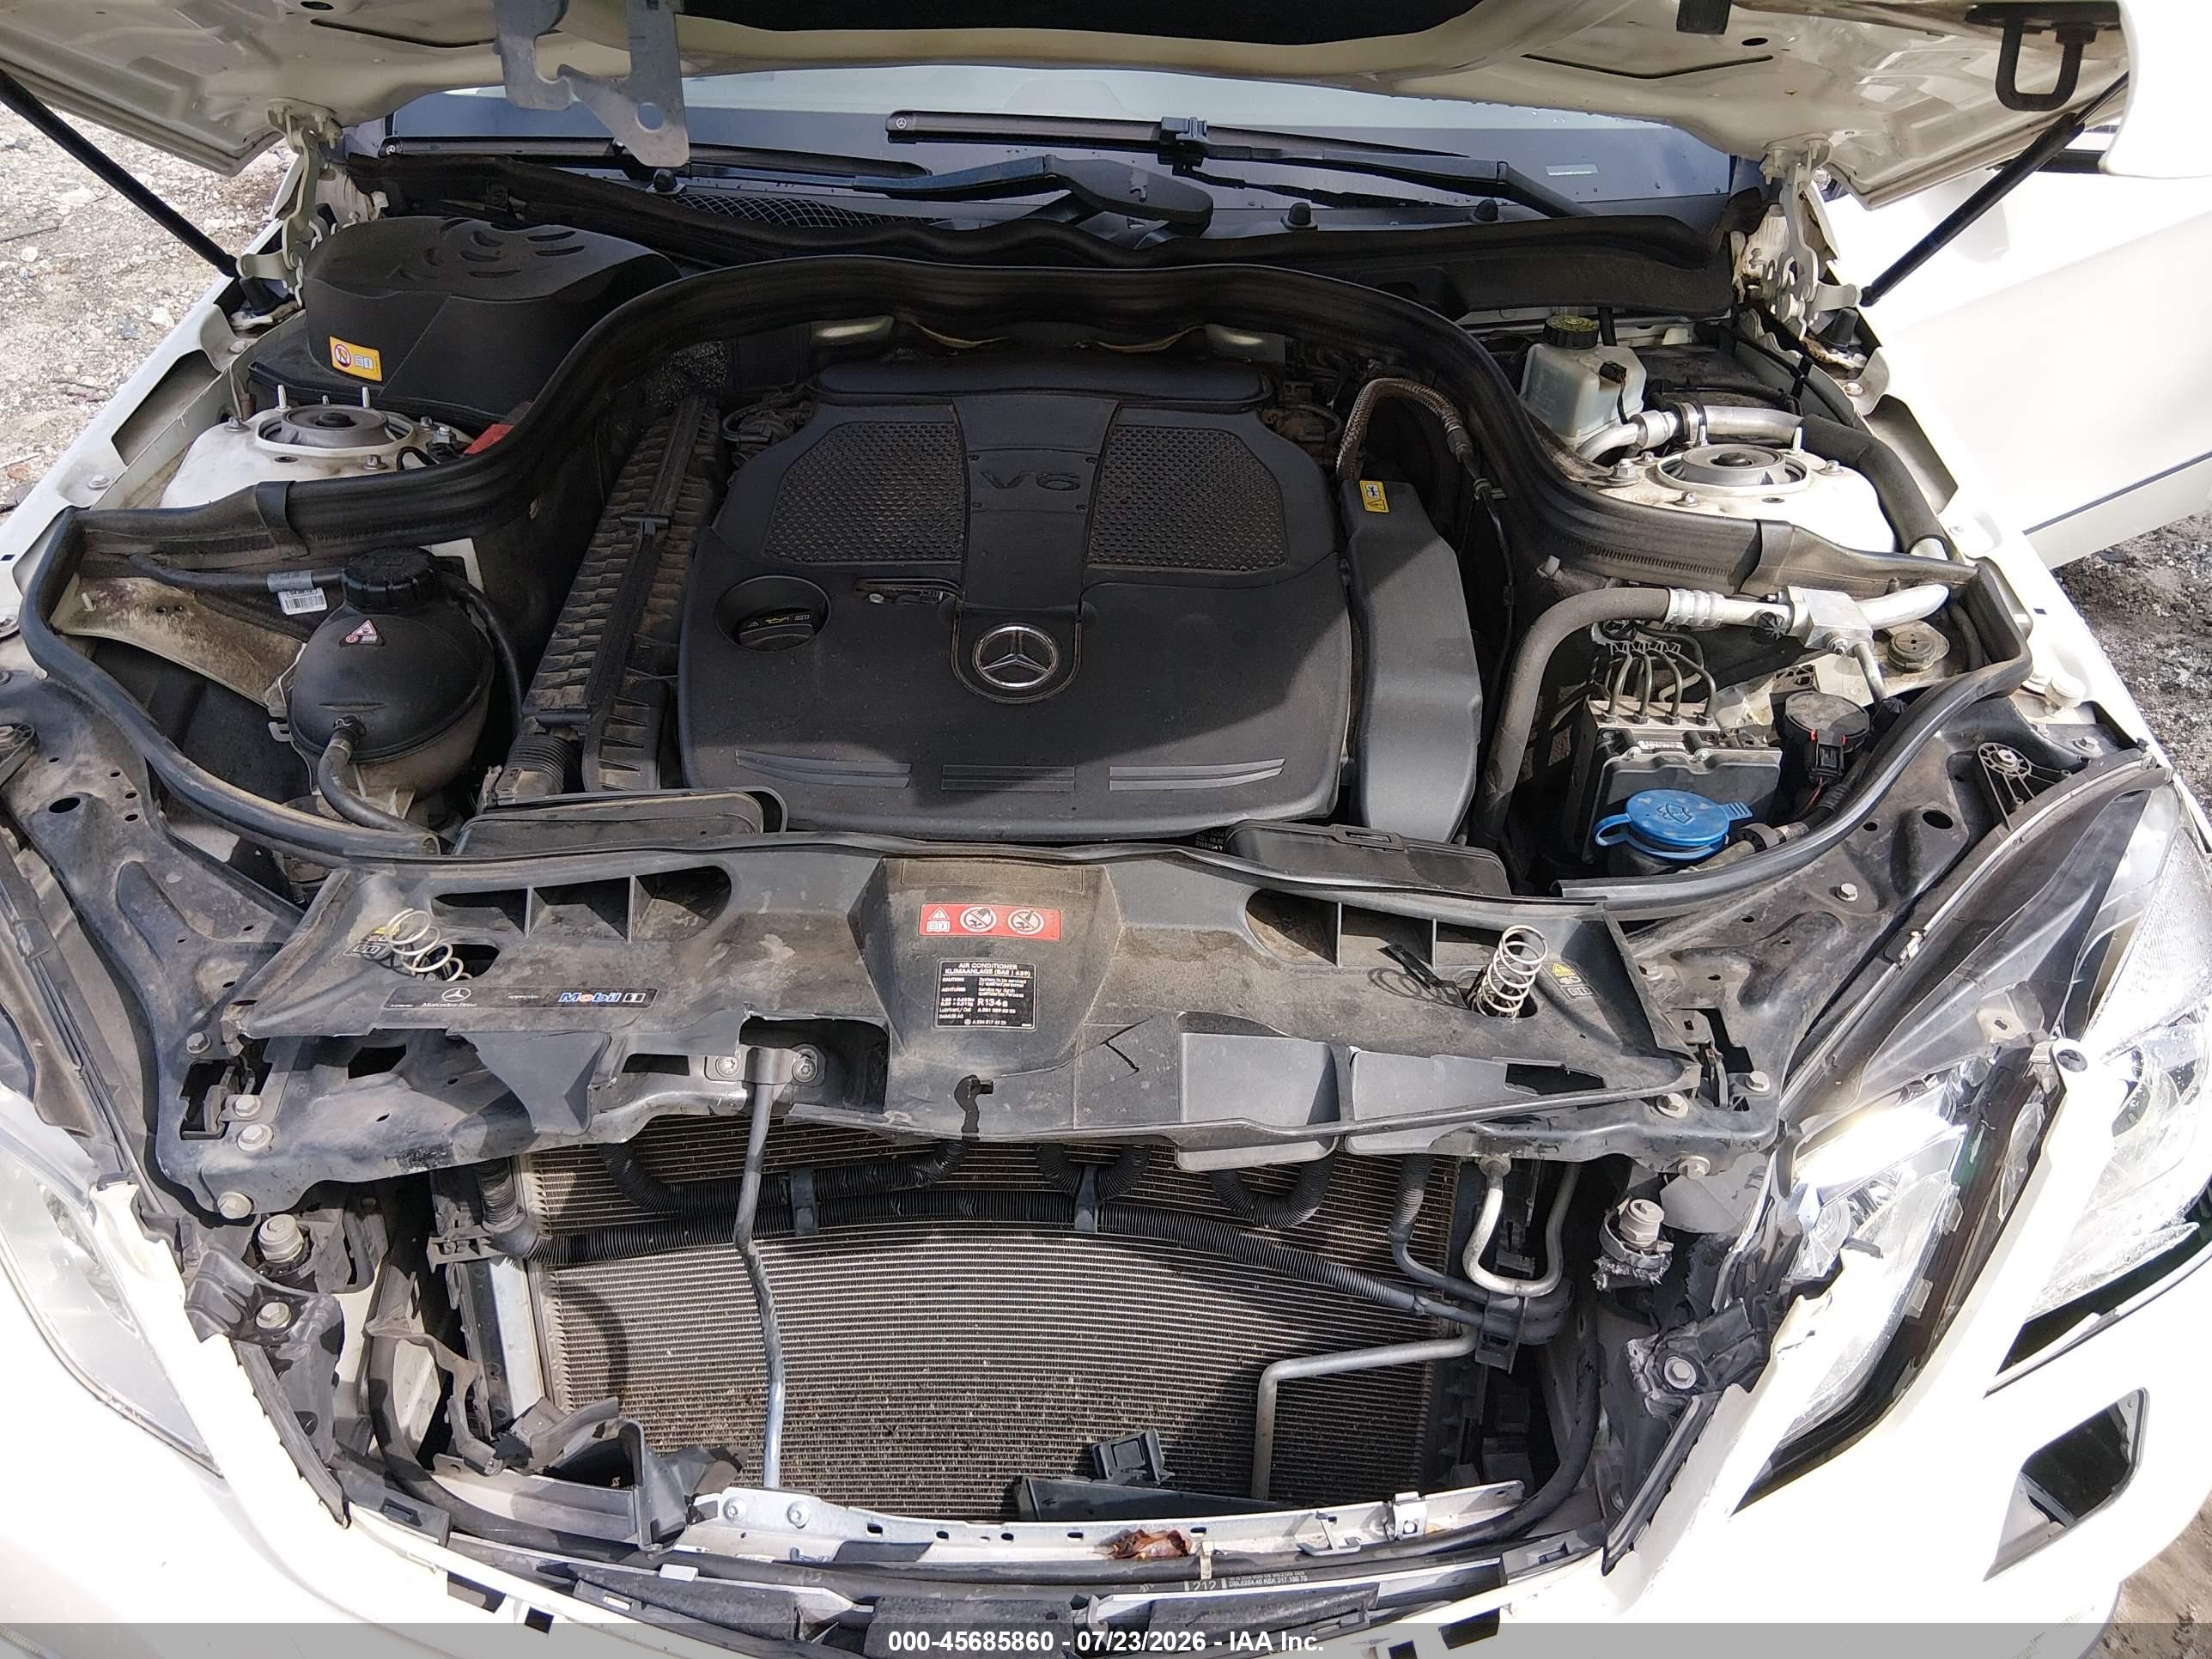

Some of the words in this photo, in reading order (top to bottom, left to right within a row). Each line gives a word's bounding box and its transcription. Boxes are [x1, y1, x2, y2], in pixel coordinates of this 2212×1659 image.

[980, 471, 1080, 491] V6
[558, 992, 622, 1003] Mobil
[1193, 1580, 1217, 1591] 212
